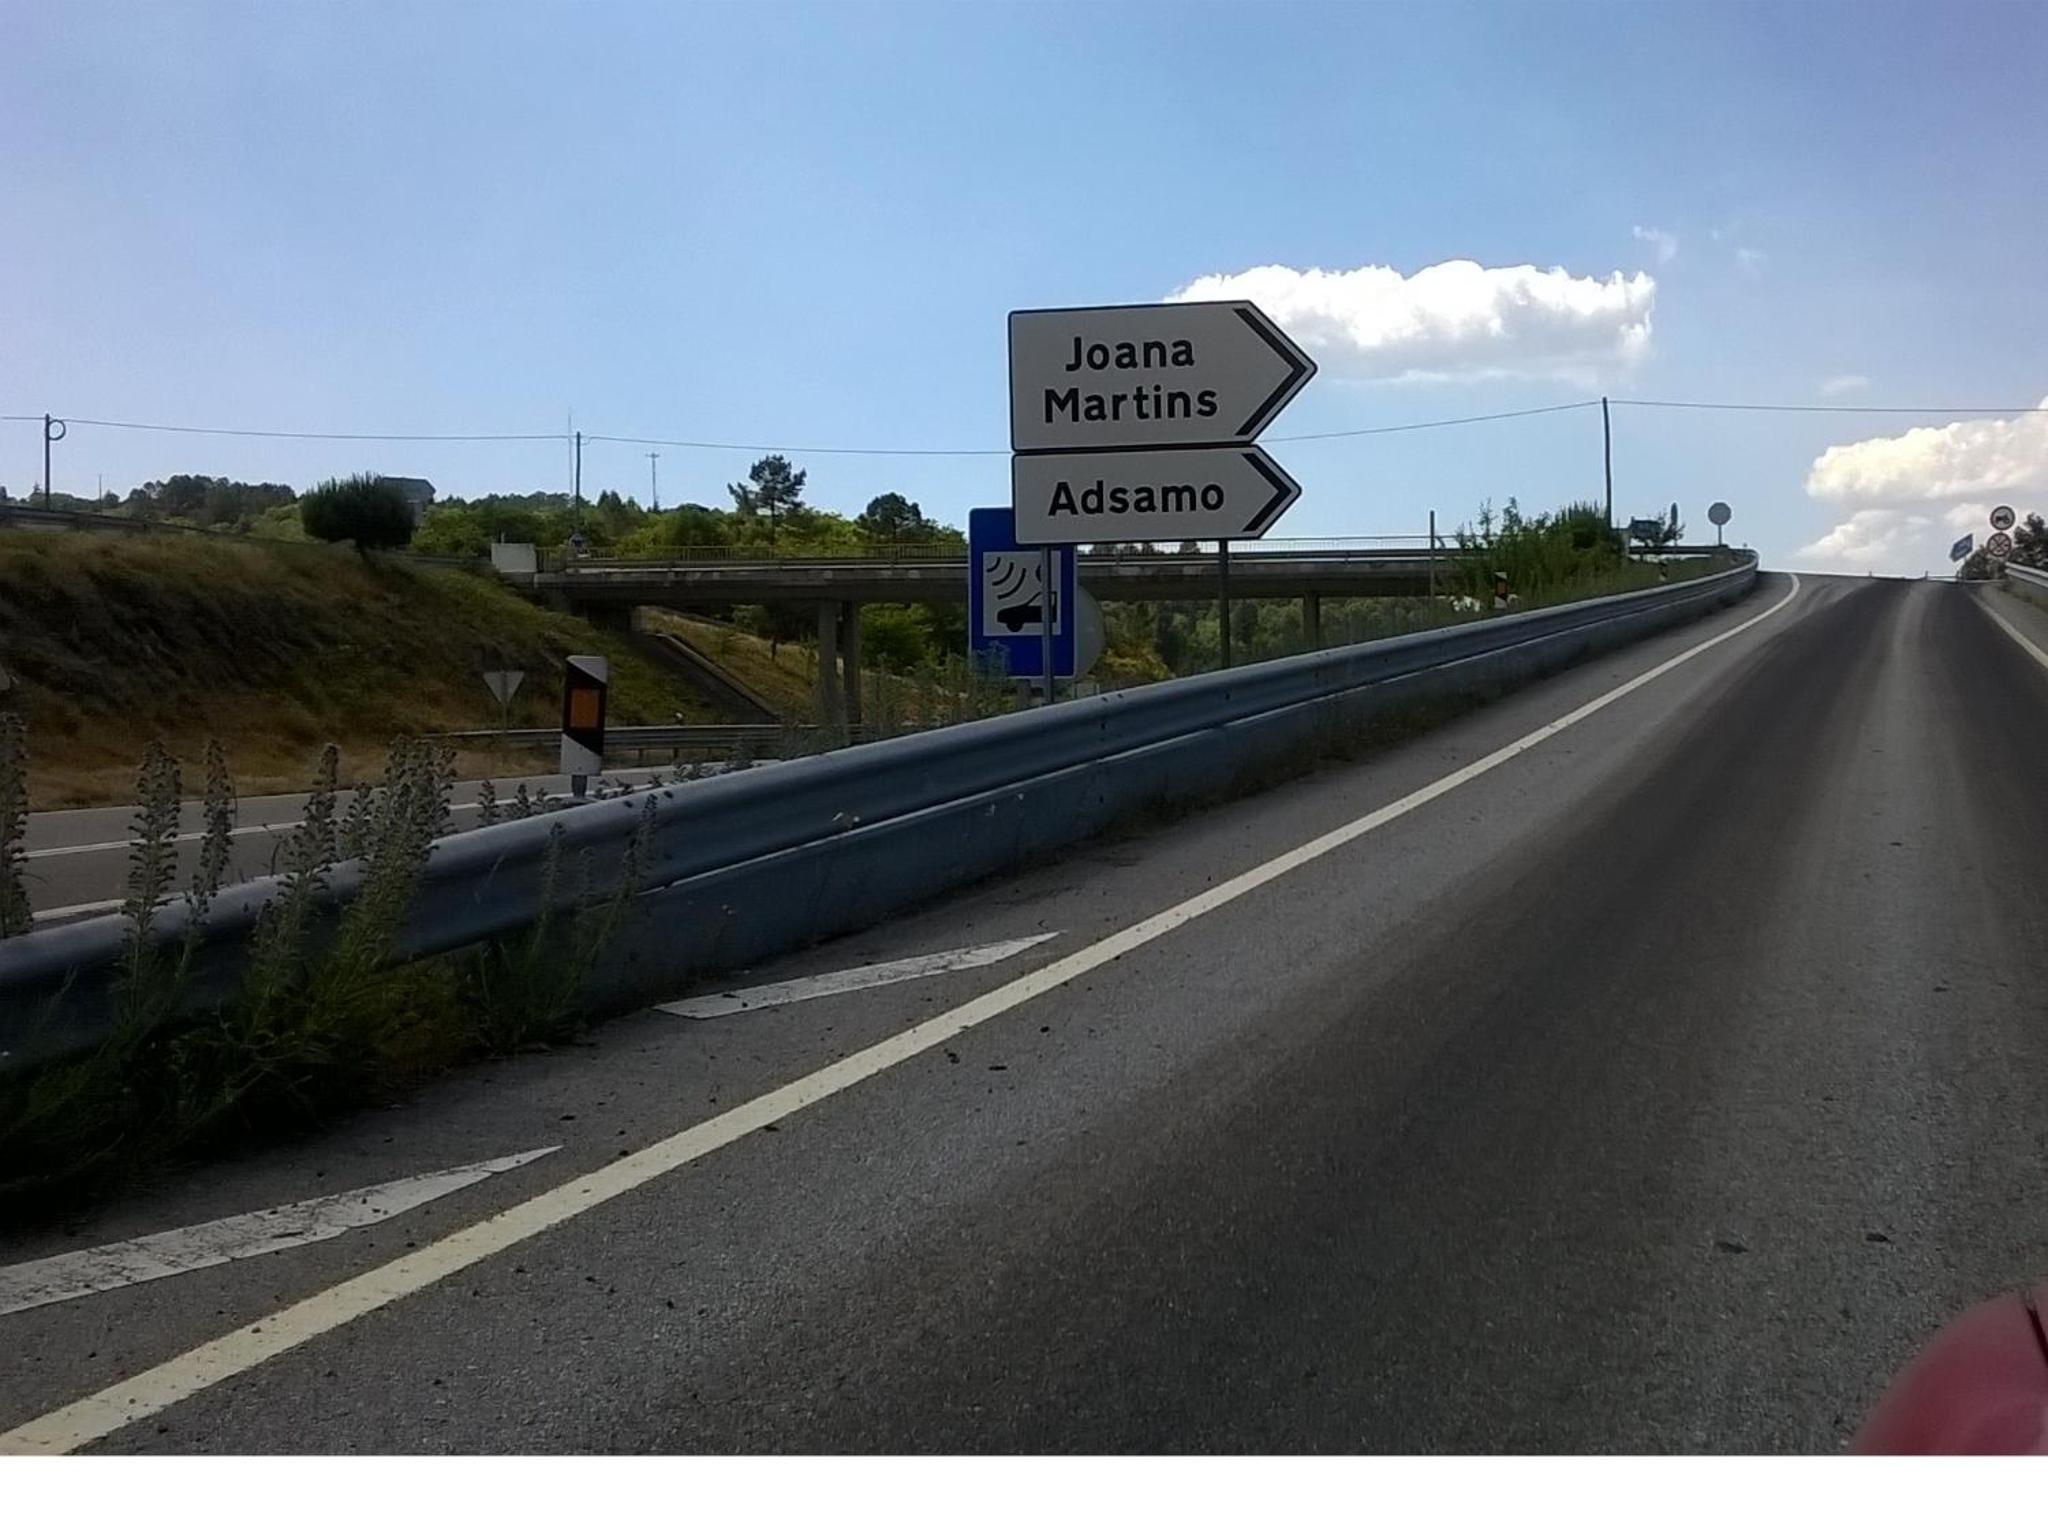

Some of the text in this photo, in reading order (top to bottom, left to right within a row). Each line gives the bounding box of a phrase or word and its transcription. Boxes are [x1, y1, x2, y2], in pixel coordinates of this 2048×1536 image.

[1065, 336, 1195, 372] Joana
[1044, 385, 1218, 424] Martins
[1047, 480, 1225, 517] Adsamo
